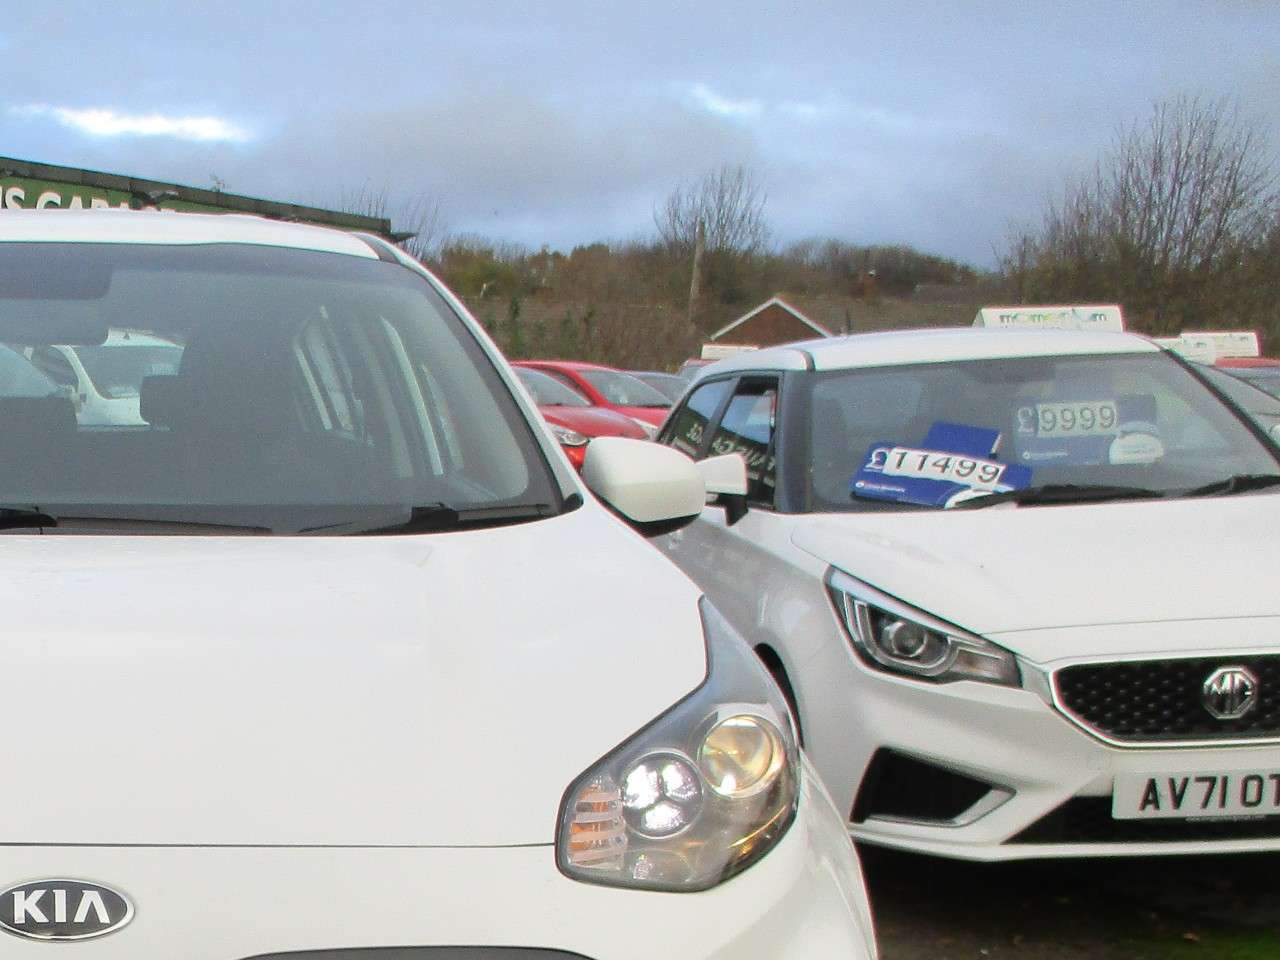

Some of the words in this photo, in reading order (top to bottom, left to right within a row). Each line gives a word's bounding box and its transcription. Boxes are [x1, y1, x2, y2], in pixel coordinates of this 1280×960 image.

[1018, 405, 1115, 433] £9999
[864, 447, 1001, 484] £11499
[1138, 776, 1228, 812] AV71
[12, 889, 111, 924] KIA
